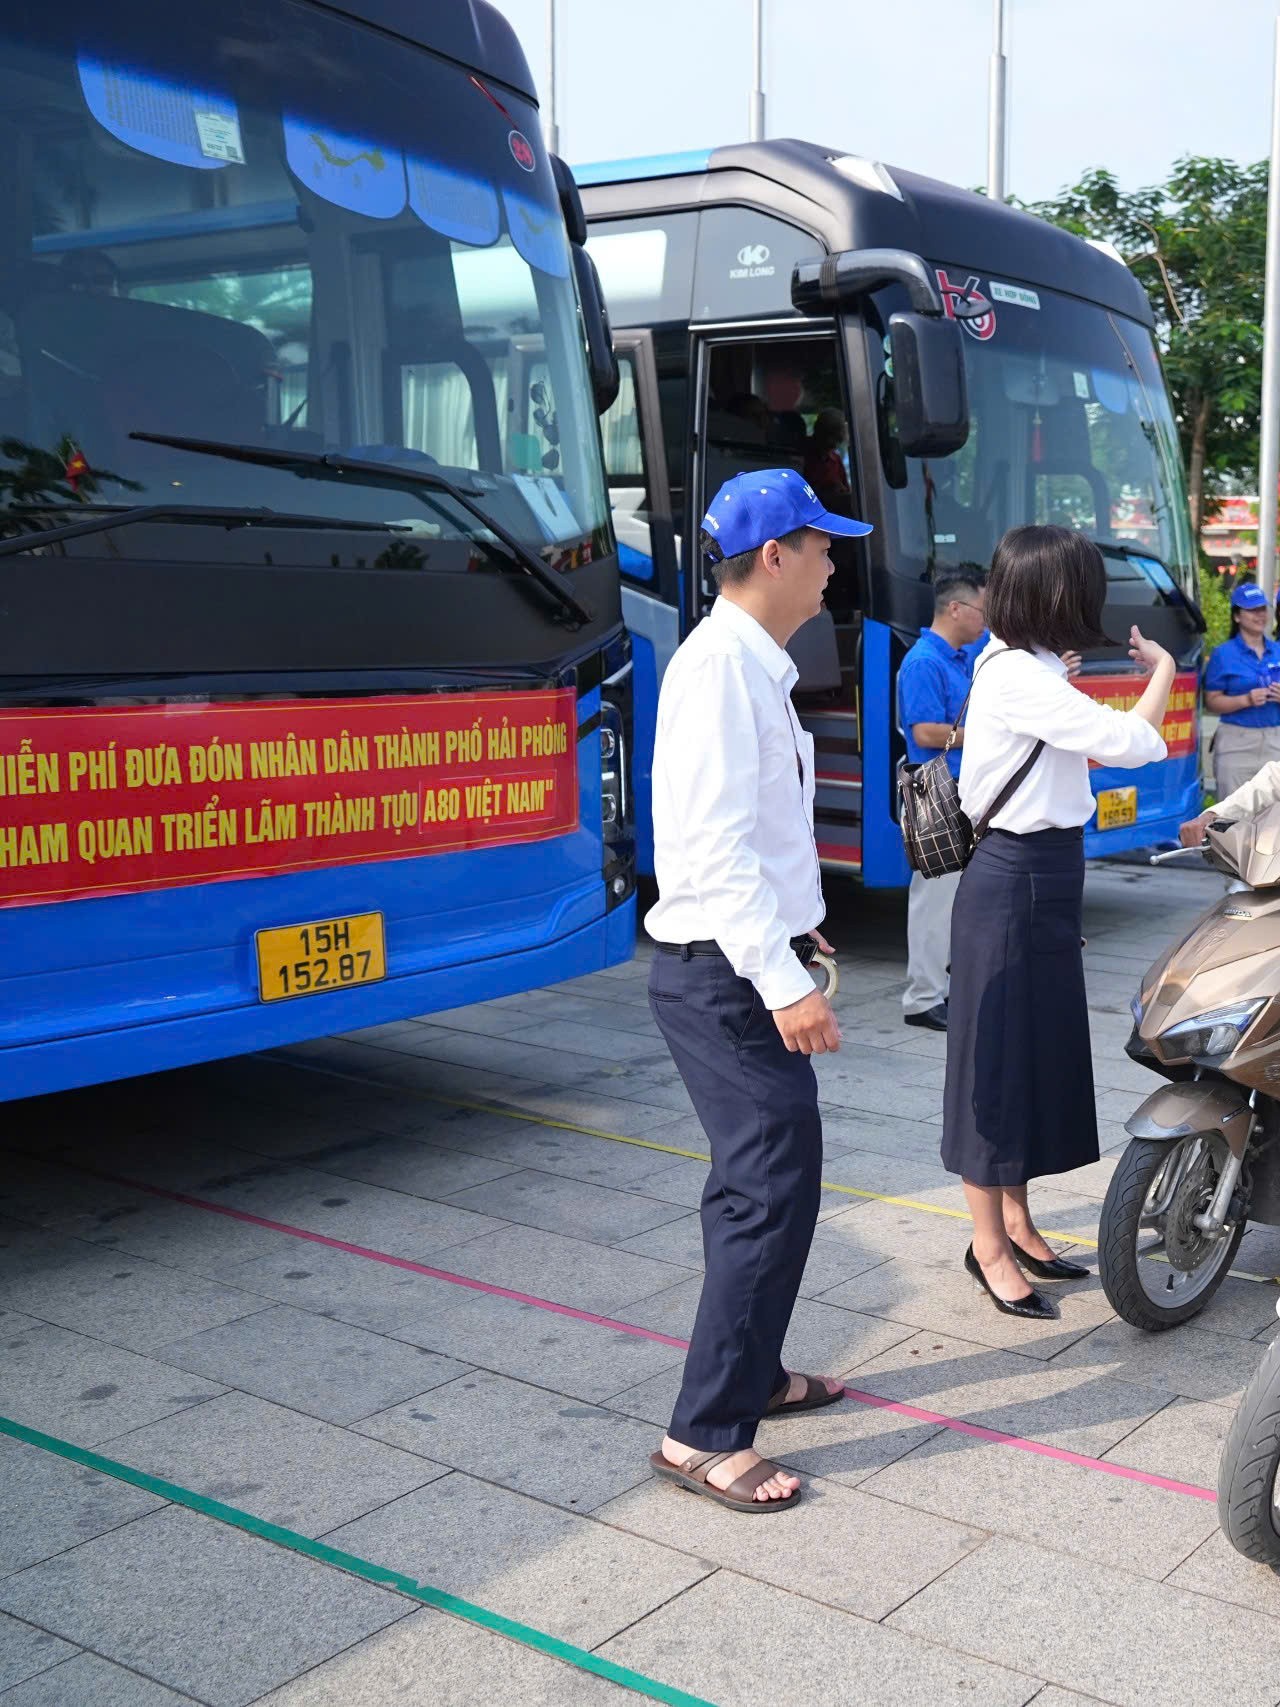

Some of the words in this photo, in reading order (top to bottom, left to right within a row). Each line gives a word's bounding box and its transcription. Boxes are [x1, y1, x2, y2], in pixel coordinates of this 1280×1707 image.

[749, 266, 775, 277] LONG
[0, 738, 59, 797] IỄN
[69, 741, 117, 791] PHÍ
[125, 743, 182, 788] ĐƯA
[189, 736, 243, 783] ĐÓN
[250, 732, 317, 779] NHÂN
[324, 730, 369, 774] DÂN
[374, 727, 440, 769] THÀNH
[446, 717, 483, 763] PHỐ
[488, 716, 516, 760] HẢI
[522, 716, 567, 757] PHÒNG
[78, 815, 153, 864] QUAN
[161, 795, 237, 852] TRIỂN
[245, 799, 297, 844] LÃM
[303, 792, 375, 838] THÀNH
[381, 790, 418, 835] TỰU
[423, 788, 460, 823] A80
[465, 778, 503, 824] VIỆT
[300, 921, 350, 956] 15H
[279, 950, 371, 993] 152.87
